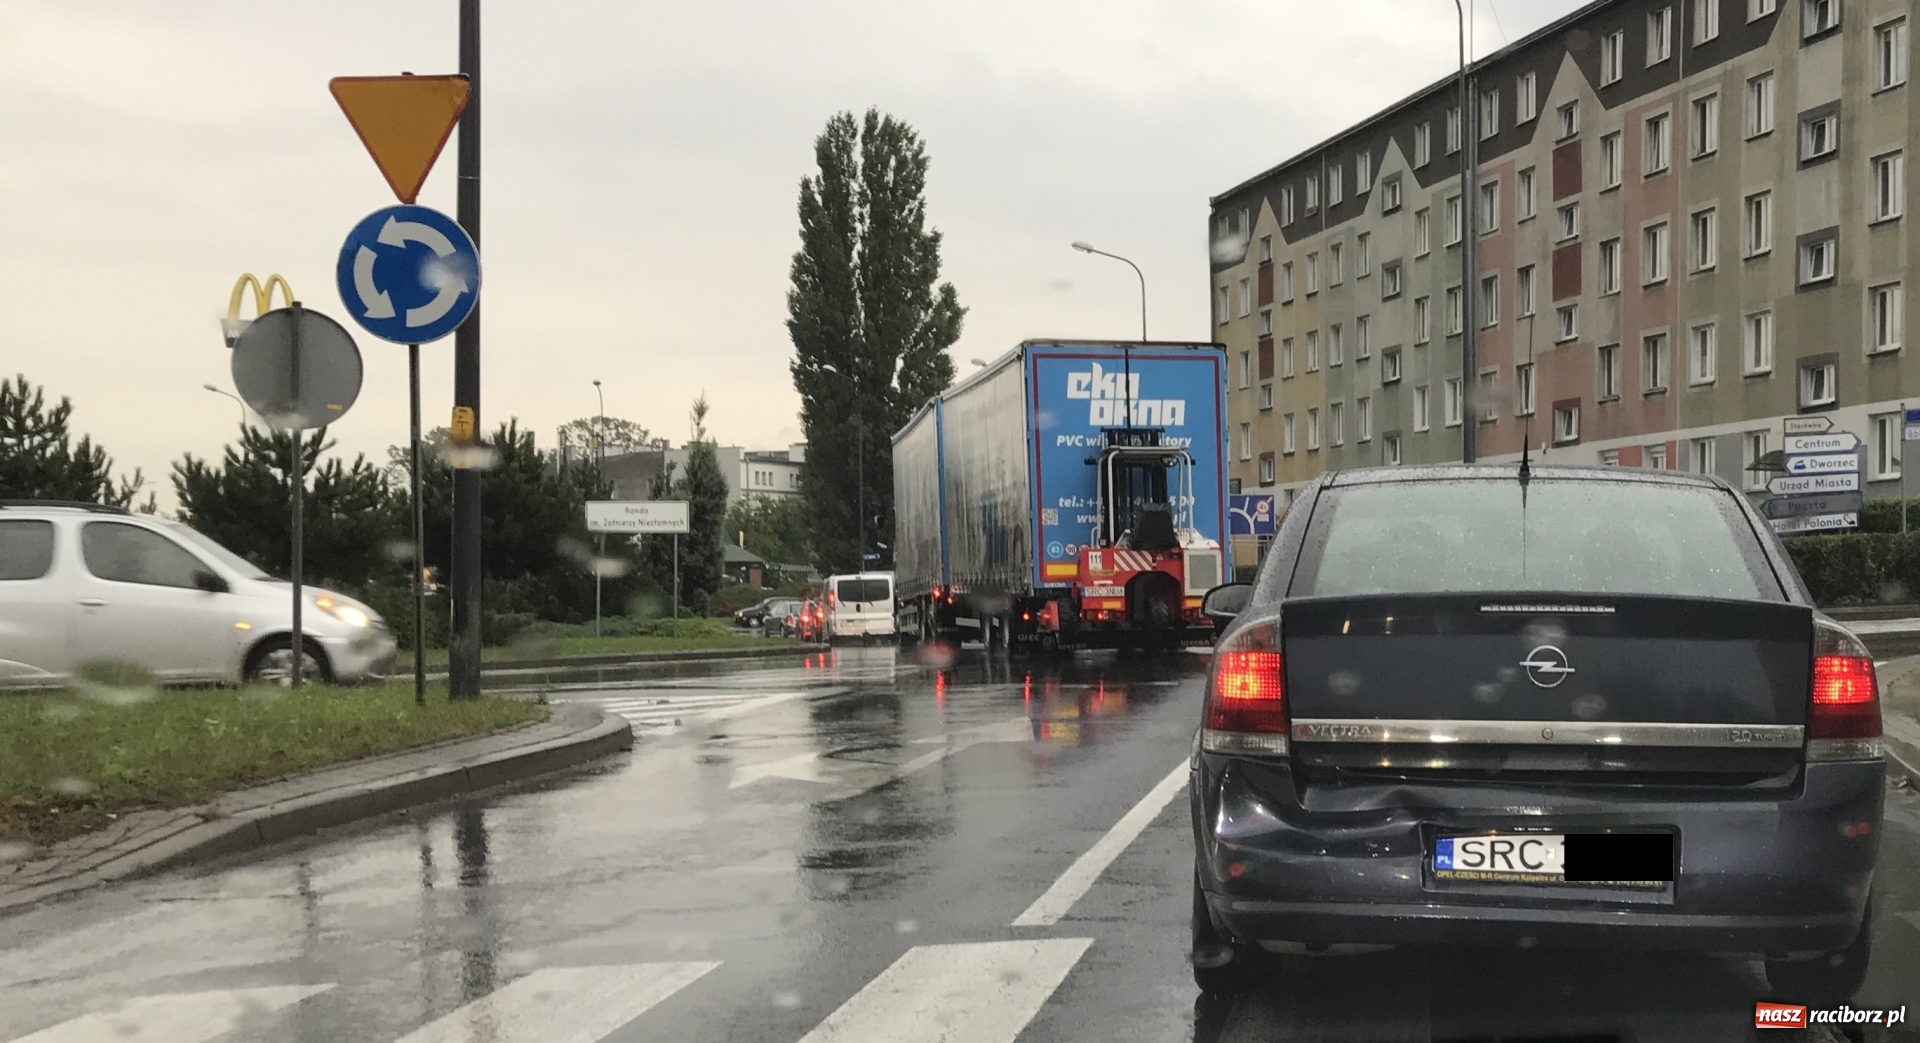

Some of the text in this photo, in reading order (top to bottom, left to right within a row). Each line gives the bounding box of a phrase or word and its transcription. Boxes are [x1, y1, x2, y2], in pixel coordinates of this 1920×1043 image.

[1067, 362, 1140, 399] eko
[1089, 400, 1186, 426] okna
[1056, 434, 1084, 447] PVC
[1795, 439, 1841, 449] Centrum
[1810, 459, 1855, 469] Dworzec
[1815, 478, 1852, 488] Miasta
[1058, 495, 1084, 508] tel.:
[625, 506, 649, 515] Rondo
[1804, 518, 1843, 529] Polonia
[1308, 725, 1372, 737] VECTRA
[1437, 855, 1451, 865] PL
[1460, 839, 1544, 870] SRC
